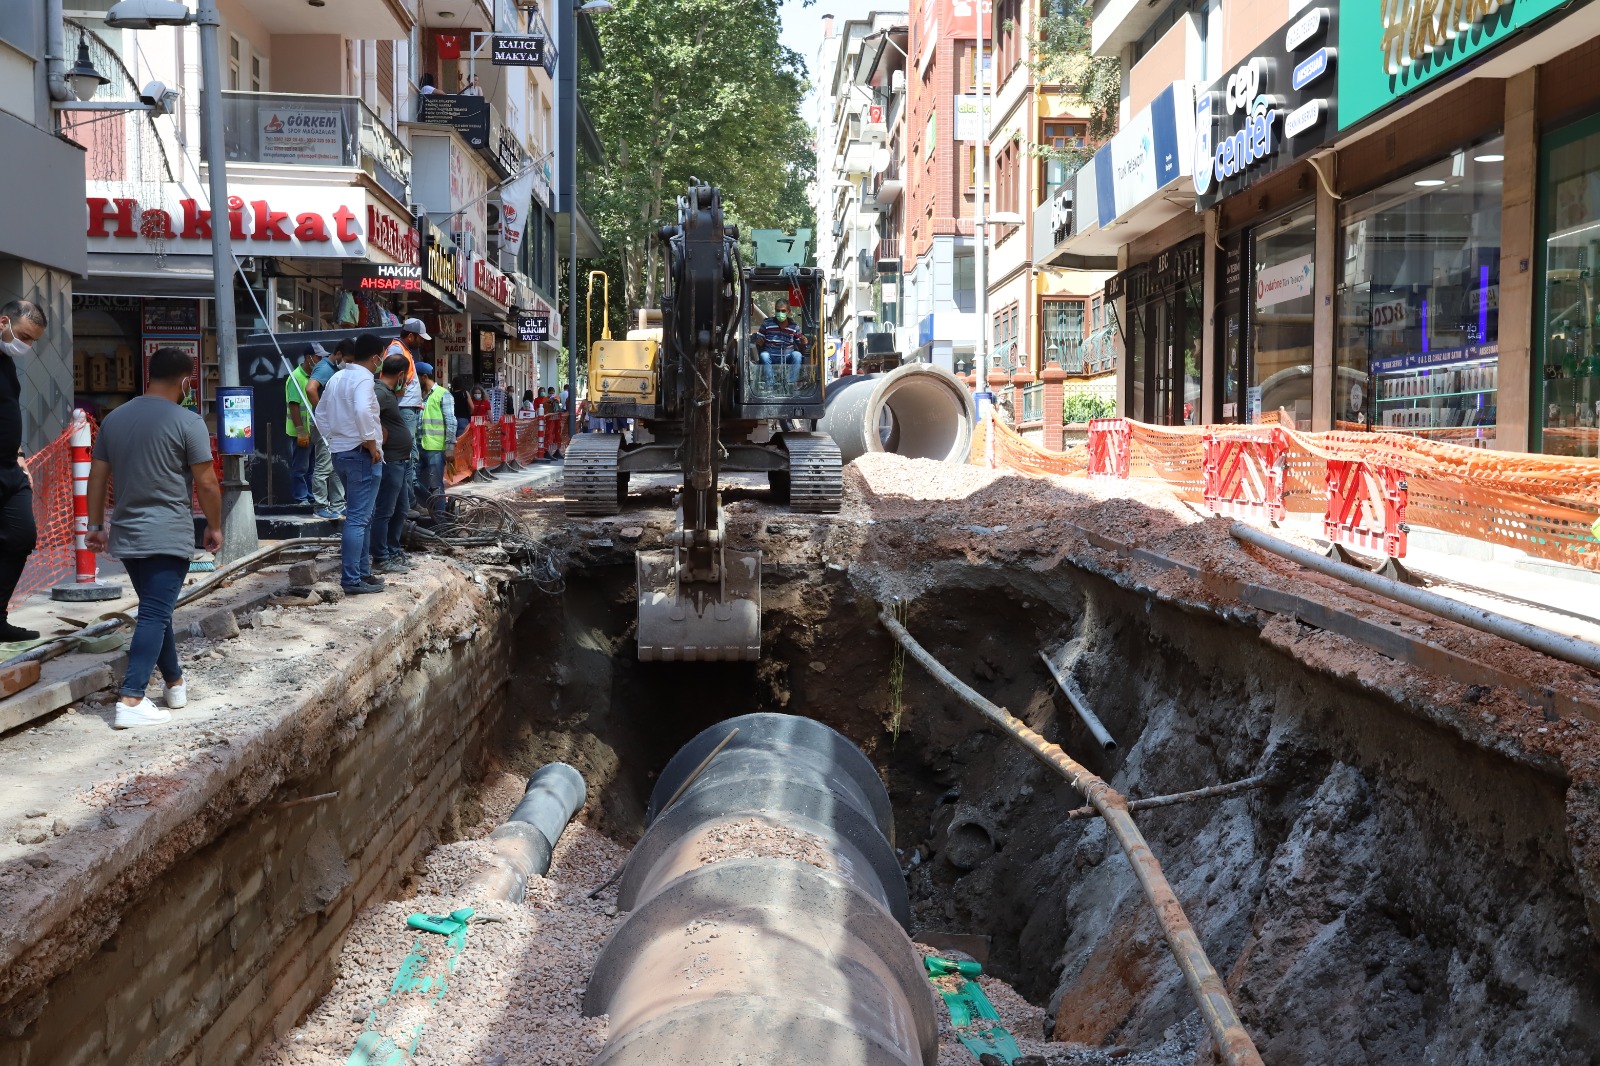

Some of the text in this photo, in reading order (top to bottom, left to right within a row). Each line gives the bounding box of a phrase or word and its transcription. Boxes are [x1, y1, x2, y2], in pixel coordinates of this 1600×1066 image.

[495, 51, 540, 61] MAKYAJ
[1226, 57, 1260, 115] cep
[287, 113, 337, 128] GÖRKEM
[1215, 109, 1275, 182] center
[87, 195, 359, 243] Hakikat
[525, 318, 543, 327] CİLT
[445, 344, 465, 352] KAĞIT
